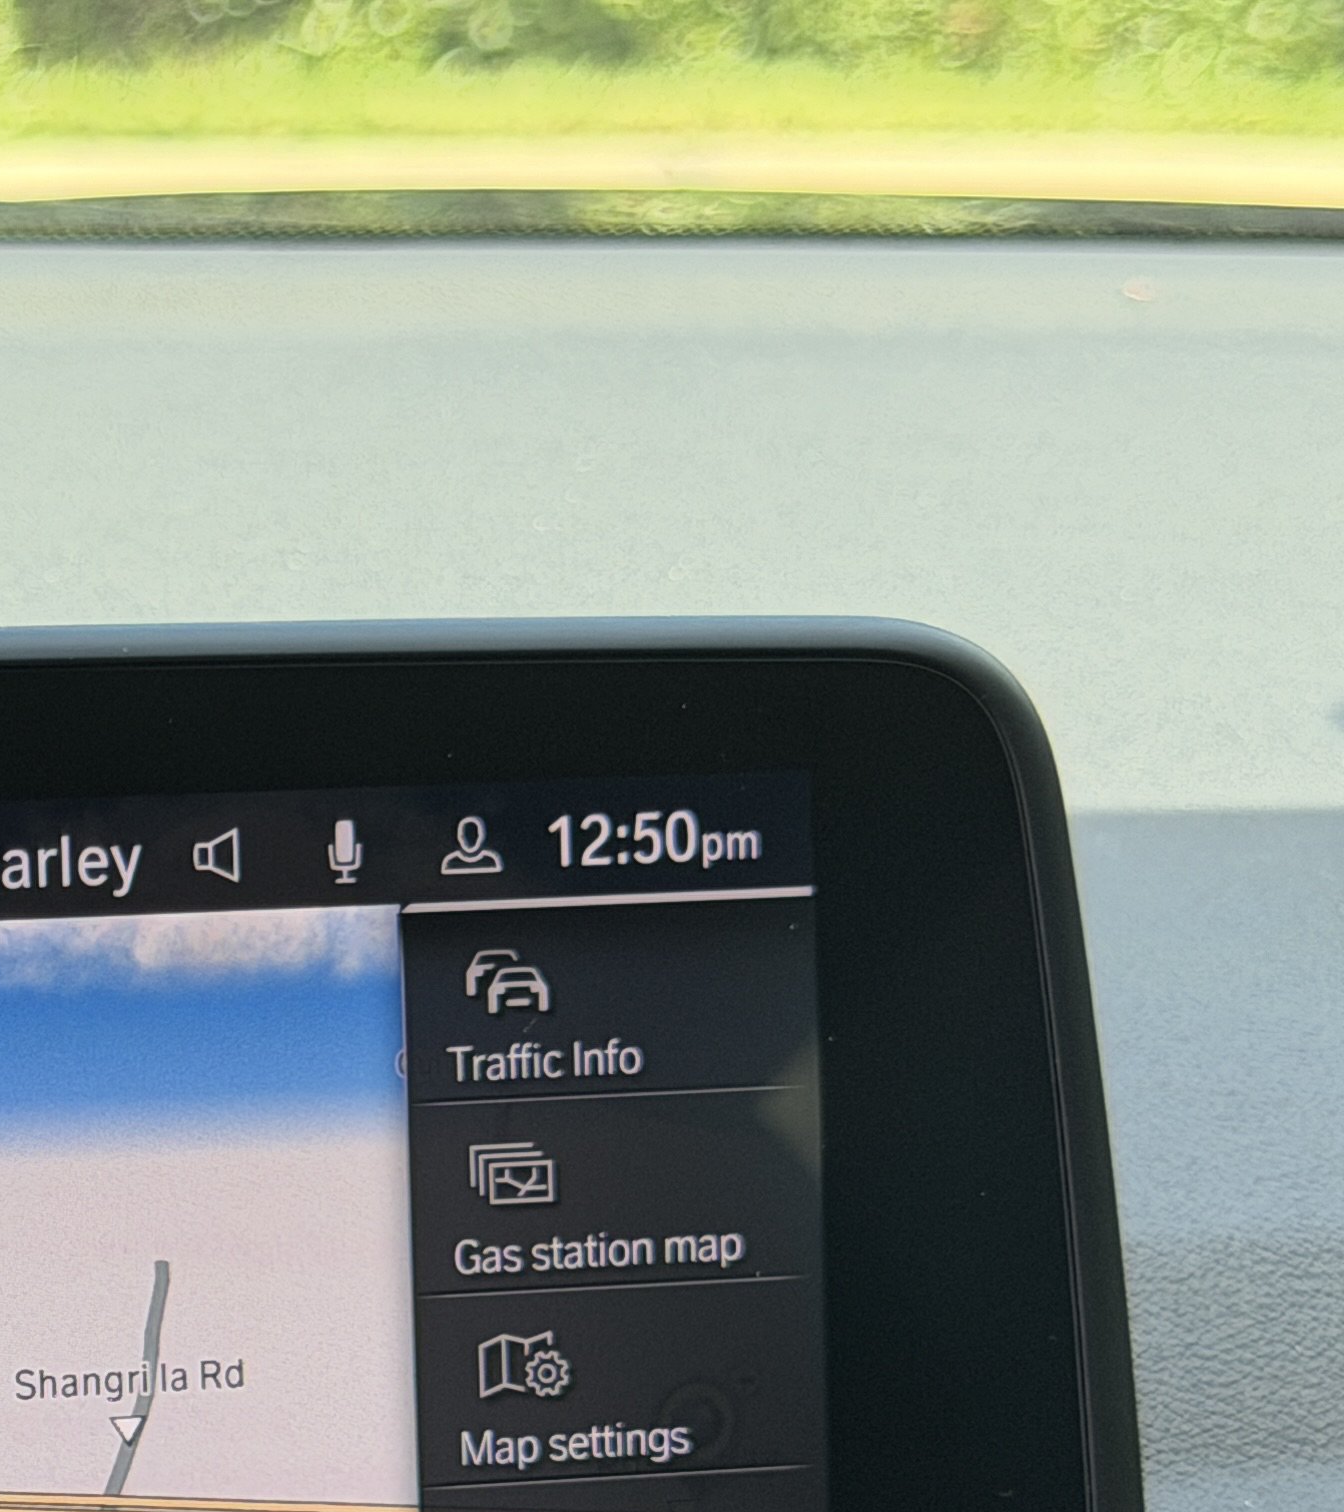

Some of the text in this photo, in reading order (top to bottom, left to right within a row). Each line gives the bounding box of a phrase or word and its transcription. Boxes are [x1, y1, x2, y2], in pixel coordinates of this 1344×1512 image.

[447, 1042, 563, 1081] Traffic
[574, 1038, 642, 1076] Info
[455, 1232, 743, 1274] Gas station map
[15, 1359, 244, 1402] Shangri la Rd
[461, 1423, 690, 1469] Map settings
